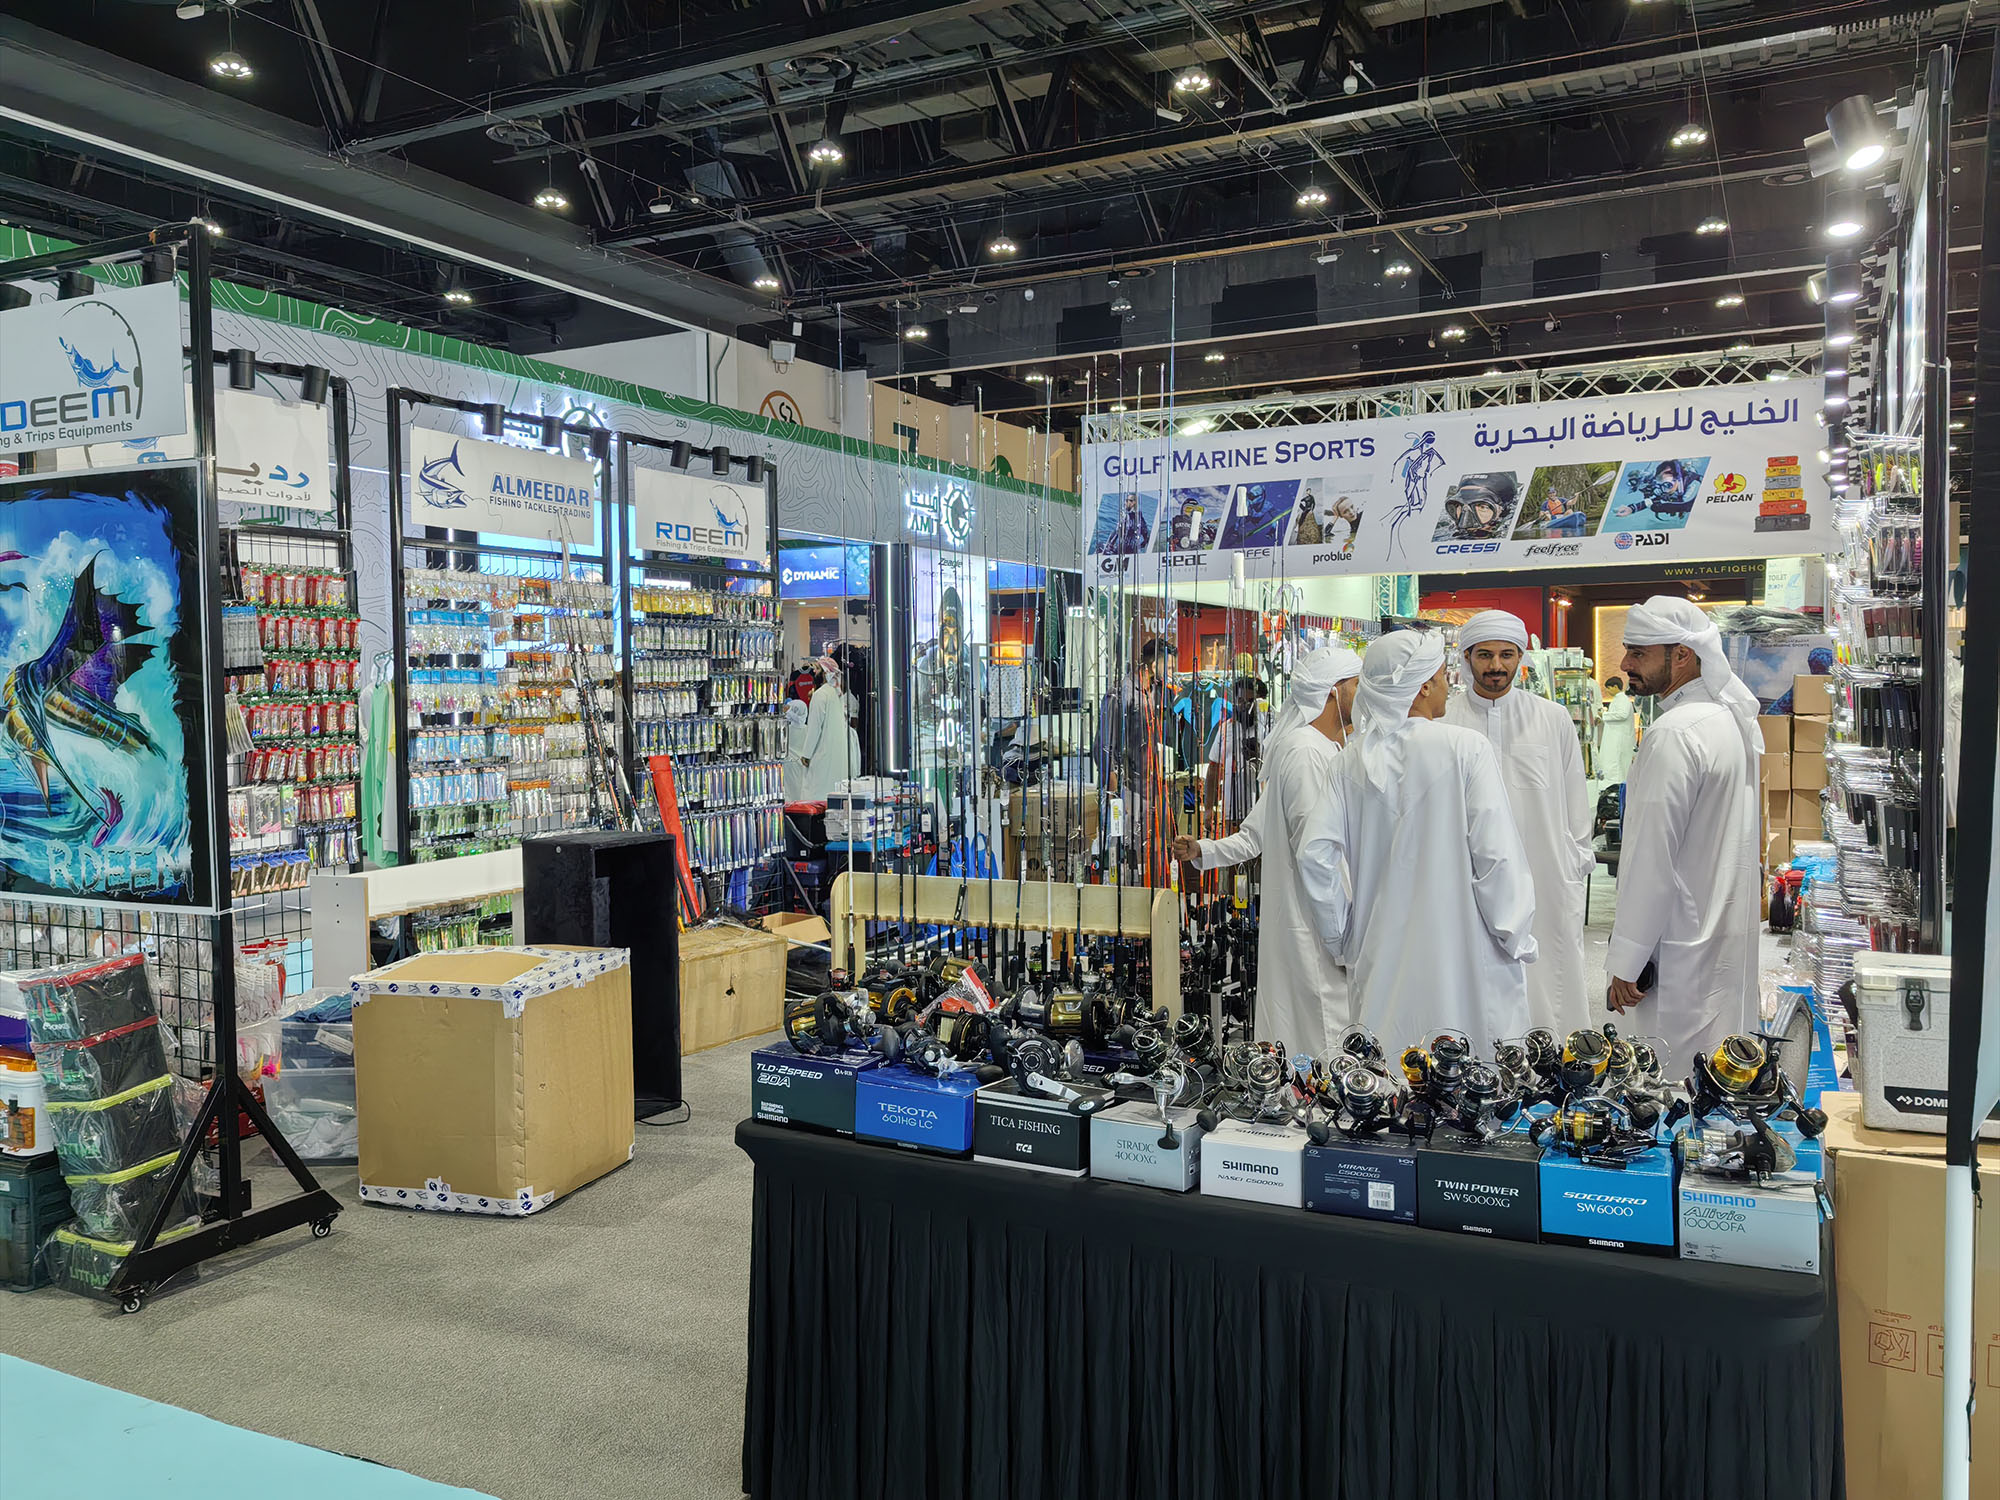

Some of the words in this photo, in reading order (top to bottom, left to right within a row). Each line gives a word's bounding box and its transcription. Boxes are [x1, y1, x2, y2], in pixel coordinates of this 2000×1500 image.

[1582, 406, 1694, 443] للرياضة
[1700, 398, 1798, 436] الخليج
[26, 430, 55, 443] Trips
[59, 421, 133, 440] Equipments
[1474, 416, 1575, 454] البحرية
[1104, 455, 1167, 477] GULF
[1172, 447, 1268, 472] MARINE
[1275, 437, 1376, 464] SPORTS
[492, 475, 590, 507] ALMEEDAR
[1706, 494, 1754, 504] PELICAN
[490, 496, 521, 508] FISHING
[524, 501, 558, 514] TACKLES
[559, 507, 591, 519] TRADING
[656, 522, 744, 547] RDEEM
[1635, 533, 1670, 546] PADI
[656, 540, 681, 550] Fishing
[689, 543, 706, 552] Trips
[707, 545, 744, 556] Equipments
[1436, 543, 1501, 555] CRESSI
[1312, 551, 1352, 564] problue
[793, 570, 840, 581] DYNAMIC
[757, 1072, 791, 1088] 20A
[756, 1112, 789, 1123] SHIMANO
[877, 1102, 938, 1120] TEKOTA
[990, 1114, 1016, 1130] TICA
[1018, 1118, 1061, 1136] FISHING
[1116, 1139, 1155, 1153] STRADIC
[1114, 1151, 1157, 1165] 4000XG
[1222, 1160, 1279, 1176] SHIMANO
[1338, 1163, 1381, 1174] MIRAVEL
[1217, 1173, 1244, 1182] NASCI
[1434, 1179, 1469, 1191] TWIN
[1471, 1183, 1519, 1197] POWER
[1562, 1191, 1647, 1206] SOCORRO
[1682, 1191, 1756, 1208] SHIMANO
[1683, 1206, 1746, 1222] Alivio
[1684, 1217, 1746, 1233] 10000FA
[1589, 1238, 1624, 1248] SHIMANO
